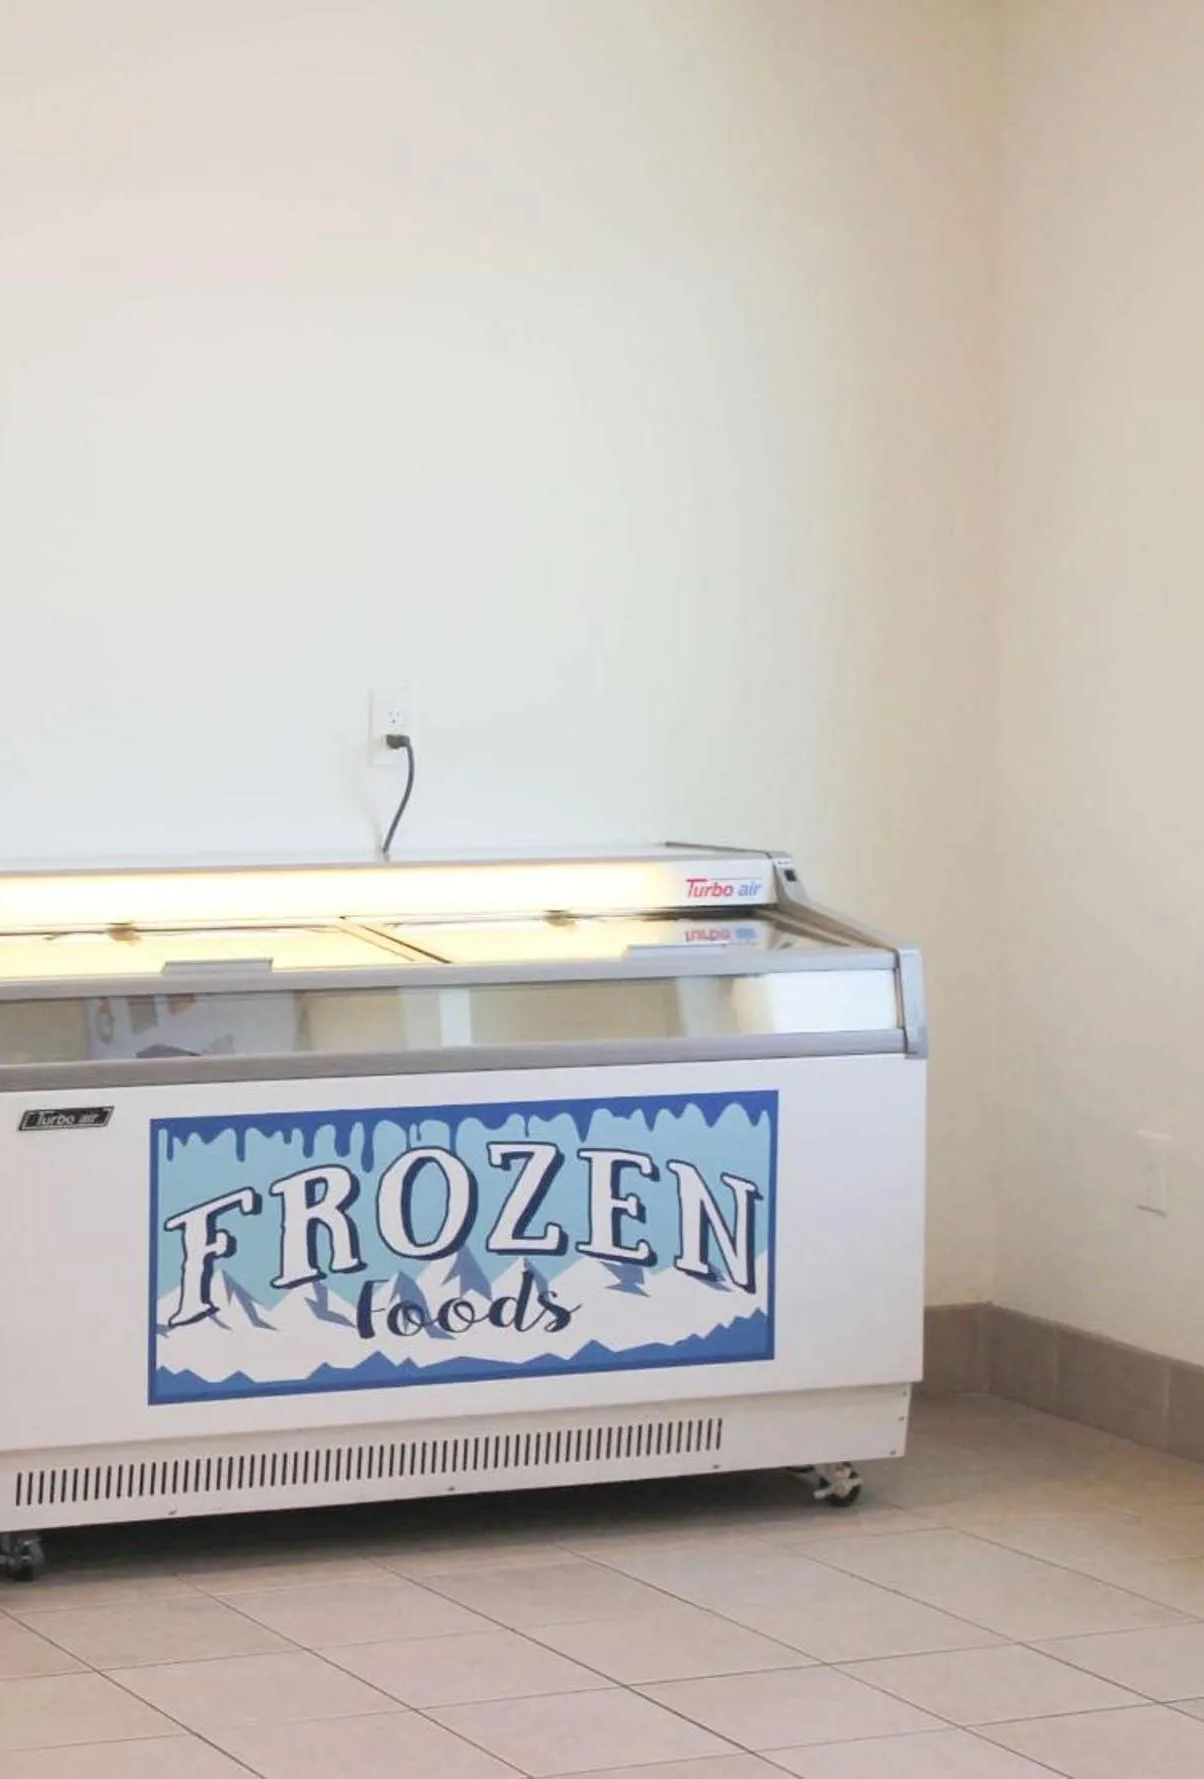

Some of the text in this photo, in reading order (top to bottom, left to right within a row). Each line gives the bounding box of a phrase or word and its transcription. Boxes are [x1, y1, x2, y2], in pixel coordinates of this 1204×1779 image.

[685, 879, 762, 898] Turbo air
[163, 1141, 763, 1328] FROZEN
